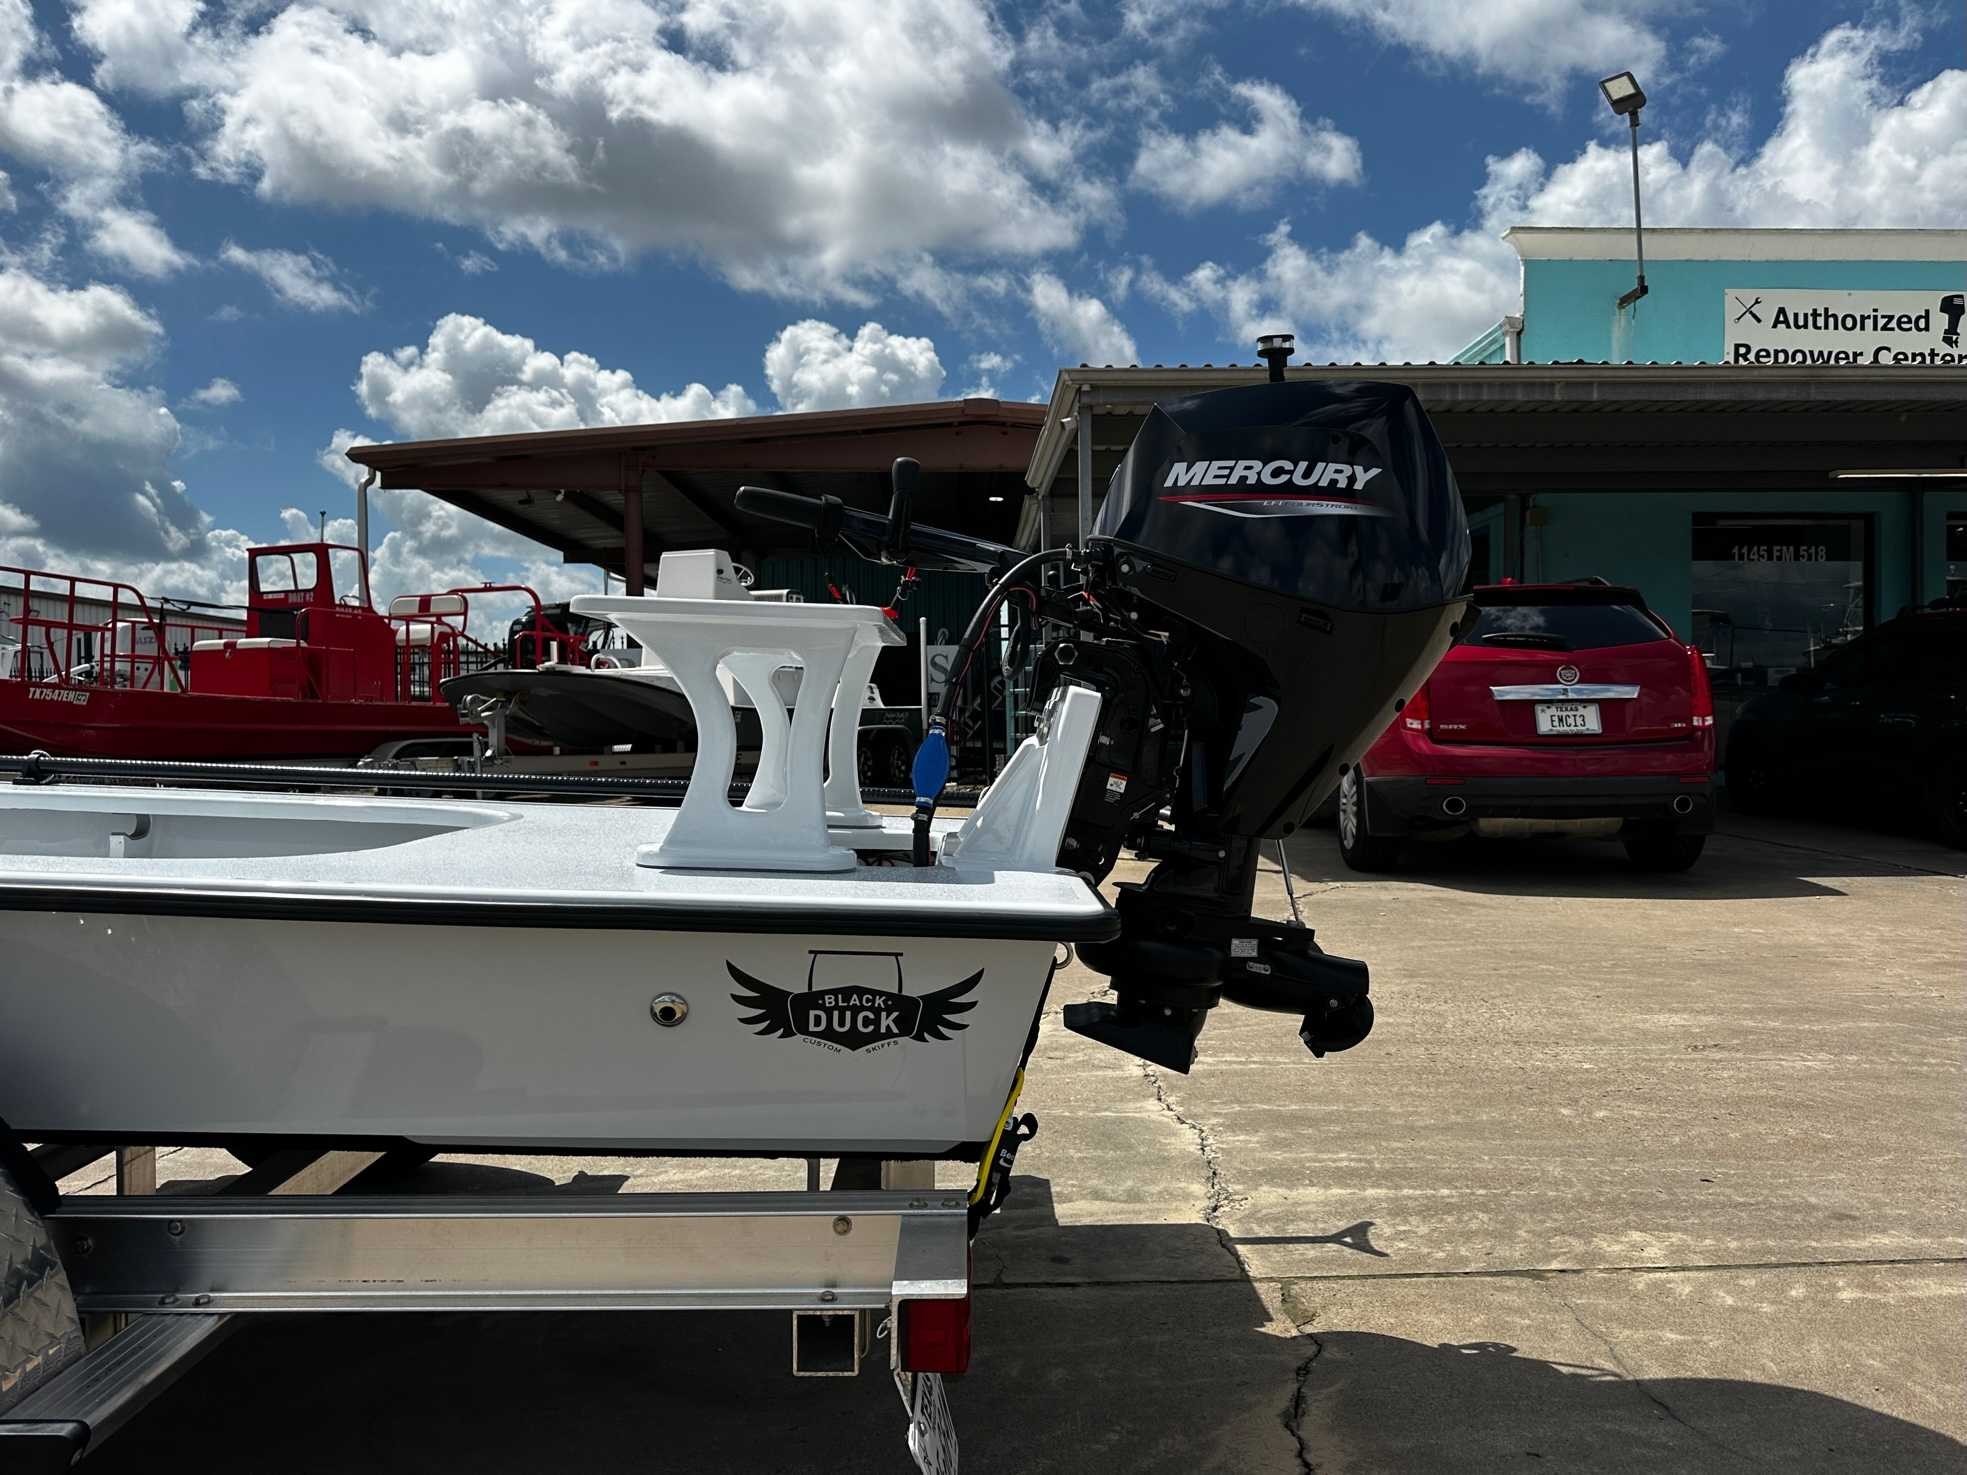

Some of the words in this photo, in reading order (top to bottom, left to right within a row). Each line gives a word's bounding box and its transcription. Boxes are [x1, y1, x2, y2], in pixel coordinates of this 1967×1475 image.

[1771, 307, 1930, 332] Authorized
[1163, 460, 1383, 490] MERCURY
[1731, 545, 1768, 562] 1145
[1773, 545, 1794, 562] FM
[1799, 545, 1827, 562] 518
[808, 1009, 900, 1034] DUCK
[802, 1037, 842, 1053] CUSTOM
[864, 1039, 899, 1054] SKIFFS
